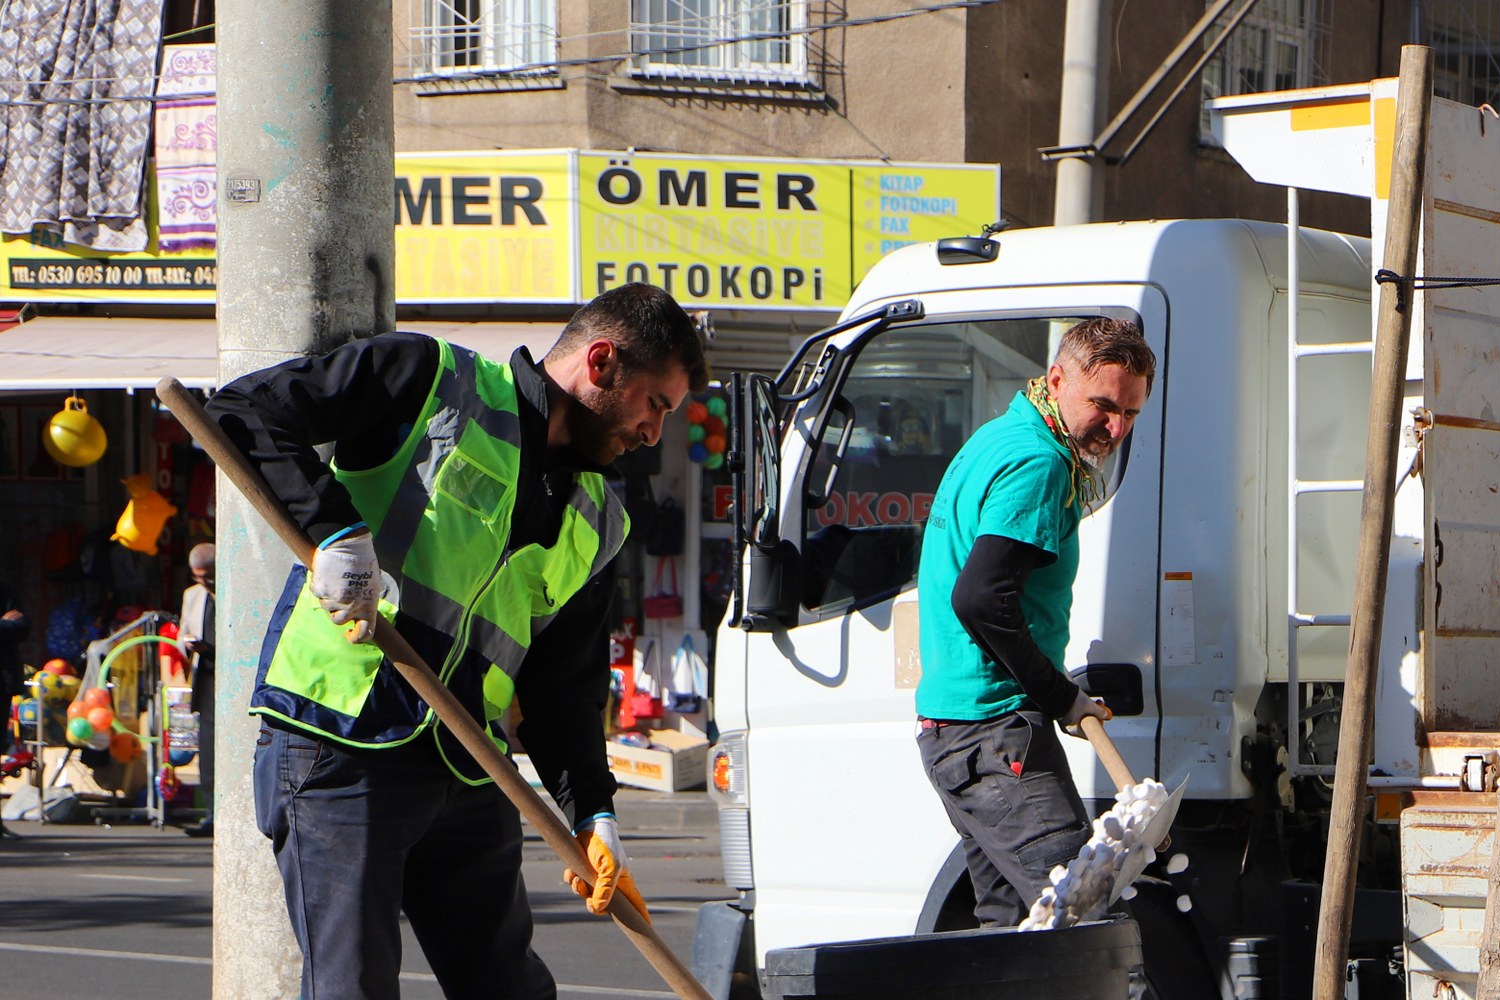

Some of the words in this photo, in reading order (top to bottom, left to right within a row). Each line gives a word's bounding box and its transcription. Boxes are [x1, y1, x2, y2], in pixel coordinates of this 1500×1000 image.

[597, 159, 818, 211] ÖMER
[881, 217, 909, 233] FAX
[38, 266, 74, 284] 0530
[76, 266, 104, 284] 695
[105, 266, 121, 284] 10
[123, 266, 142, 284] 00
[342, 571, 374, 581] Beybi
